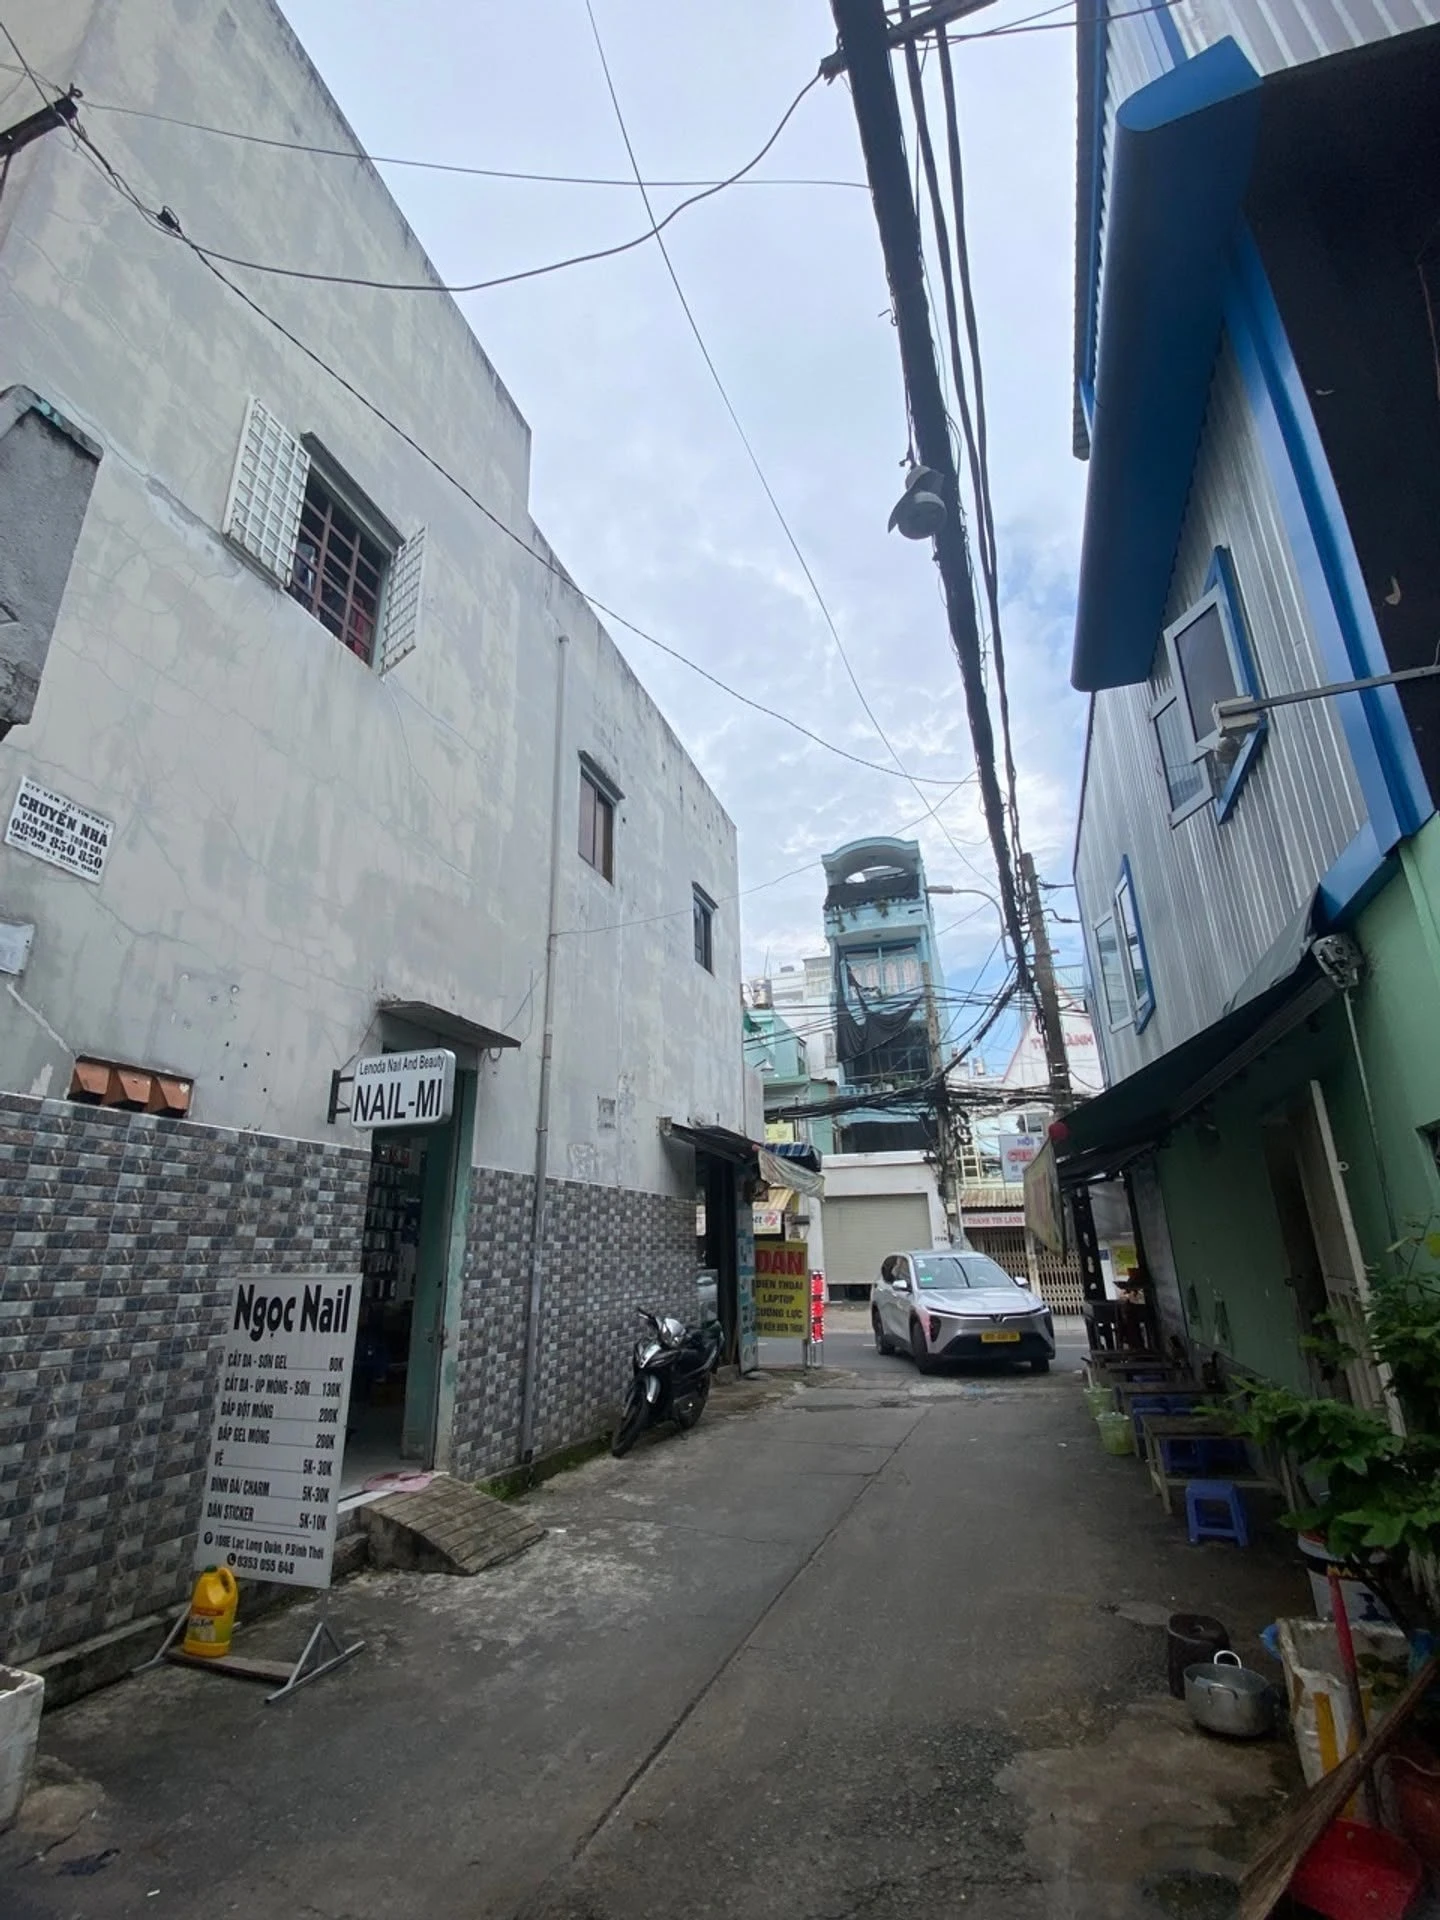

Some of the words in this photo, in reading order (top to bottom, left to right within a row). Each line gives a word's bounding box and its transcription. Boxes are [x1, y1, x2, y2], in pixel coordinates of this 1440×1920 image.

[19, 792, 77, 832] CHUYỂN
[80, 822, 108, 847] NHÀ
[11, 817, 47, 843] 0899
[49, 836, 76, 856] 850
[78, 849, 102, 869] 850
[387, 1057, 402, 1073] Nail
[402, 1056, 418, 1071] And
[419, 1053, 445, 1071] Beauty
[762, 1293, 795, 1304] LAPTOP
[233, 1284, 296, 1342] Ngọc
[300, 1284, 352, 1333] Nail
[274, 1354, 288, 1370] GEL
[233, 1427, 247, 1443] GEL
[243, 1479, 271, 1497] CHARM
[223, 1503, 255, 1522] STICKER
[232, 1536, 244, 1553] Lạc
[246, 1538, 263, 1553] Long
